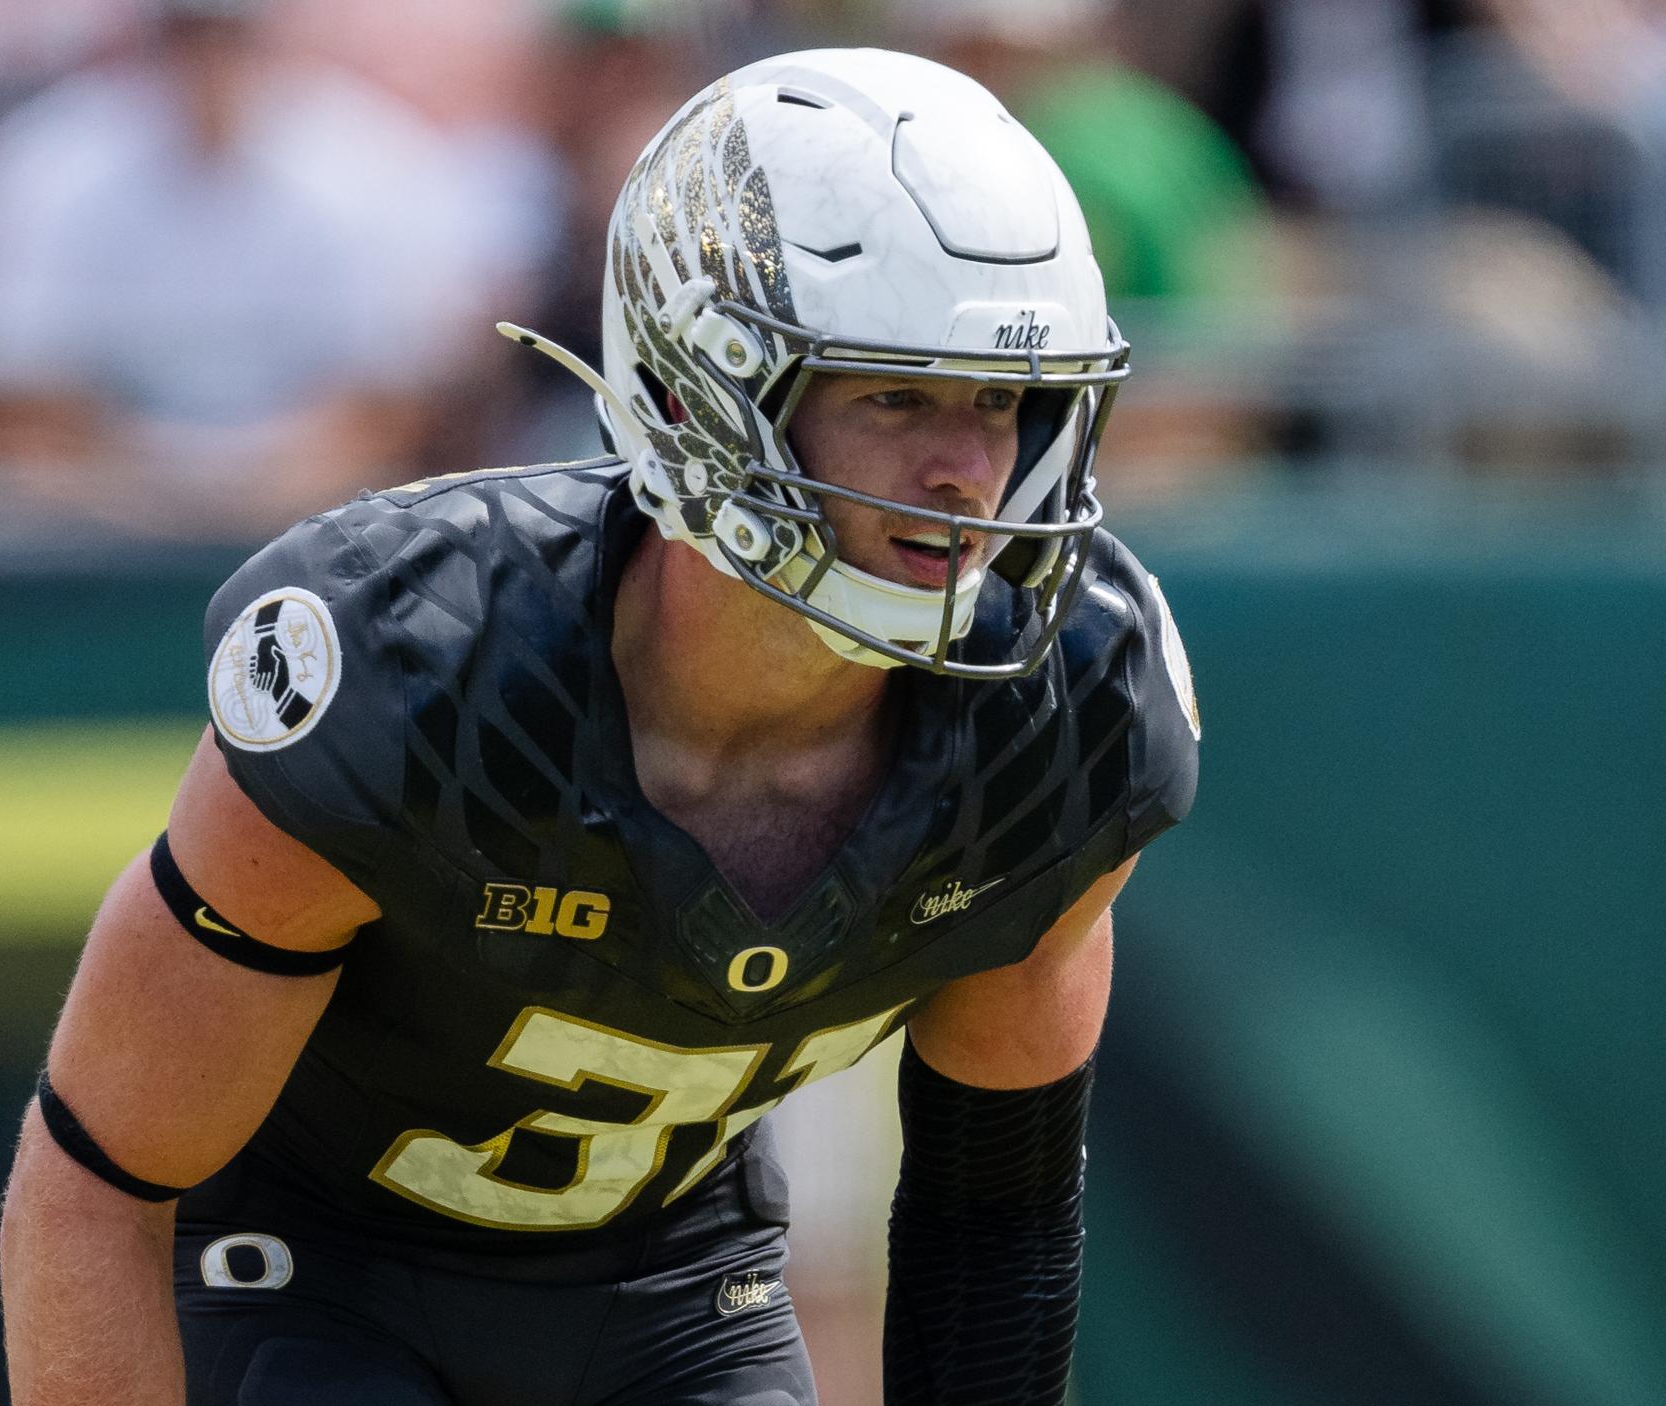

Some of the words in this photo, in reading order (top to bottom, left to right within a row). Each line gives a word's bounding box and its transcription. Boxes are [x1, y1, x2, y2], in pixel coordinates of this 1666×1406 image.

[993, 310, 1050, 350] nike
[728, 946, 788, 992] O
[200, 1232, 294, 1290] O
